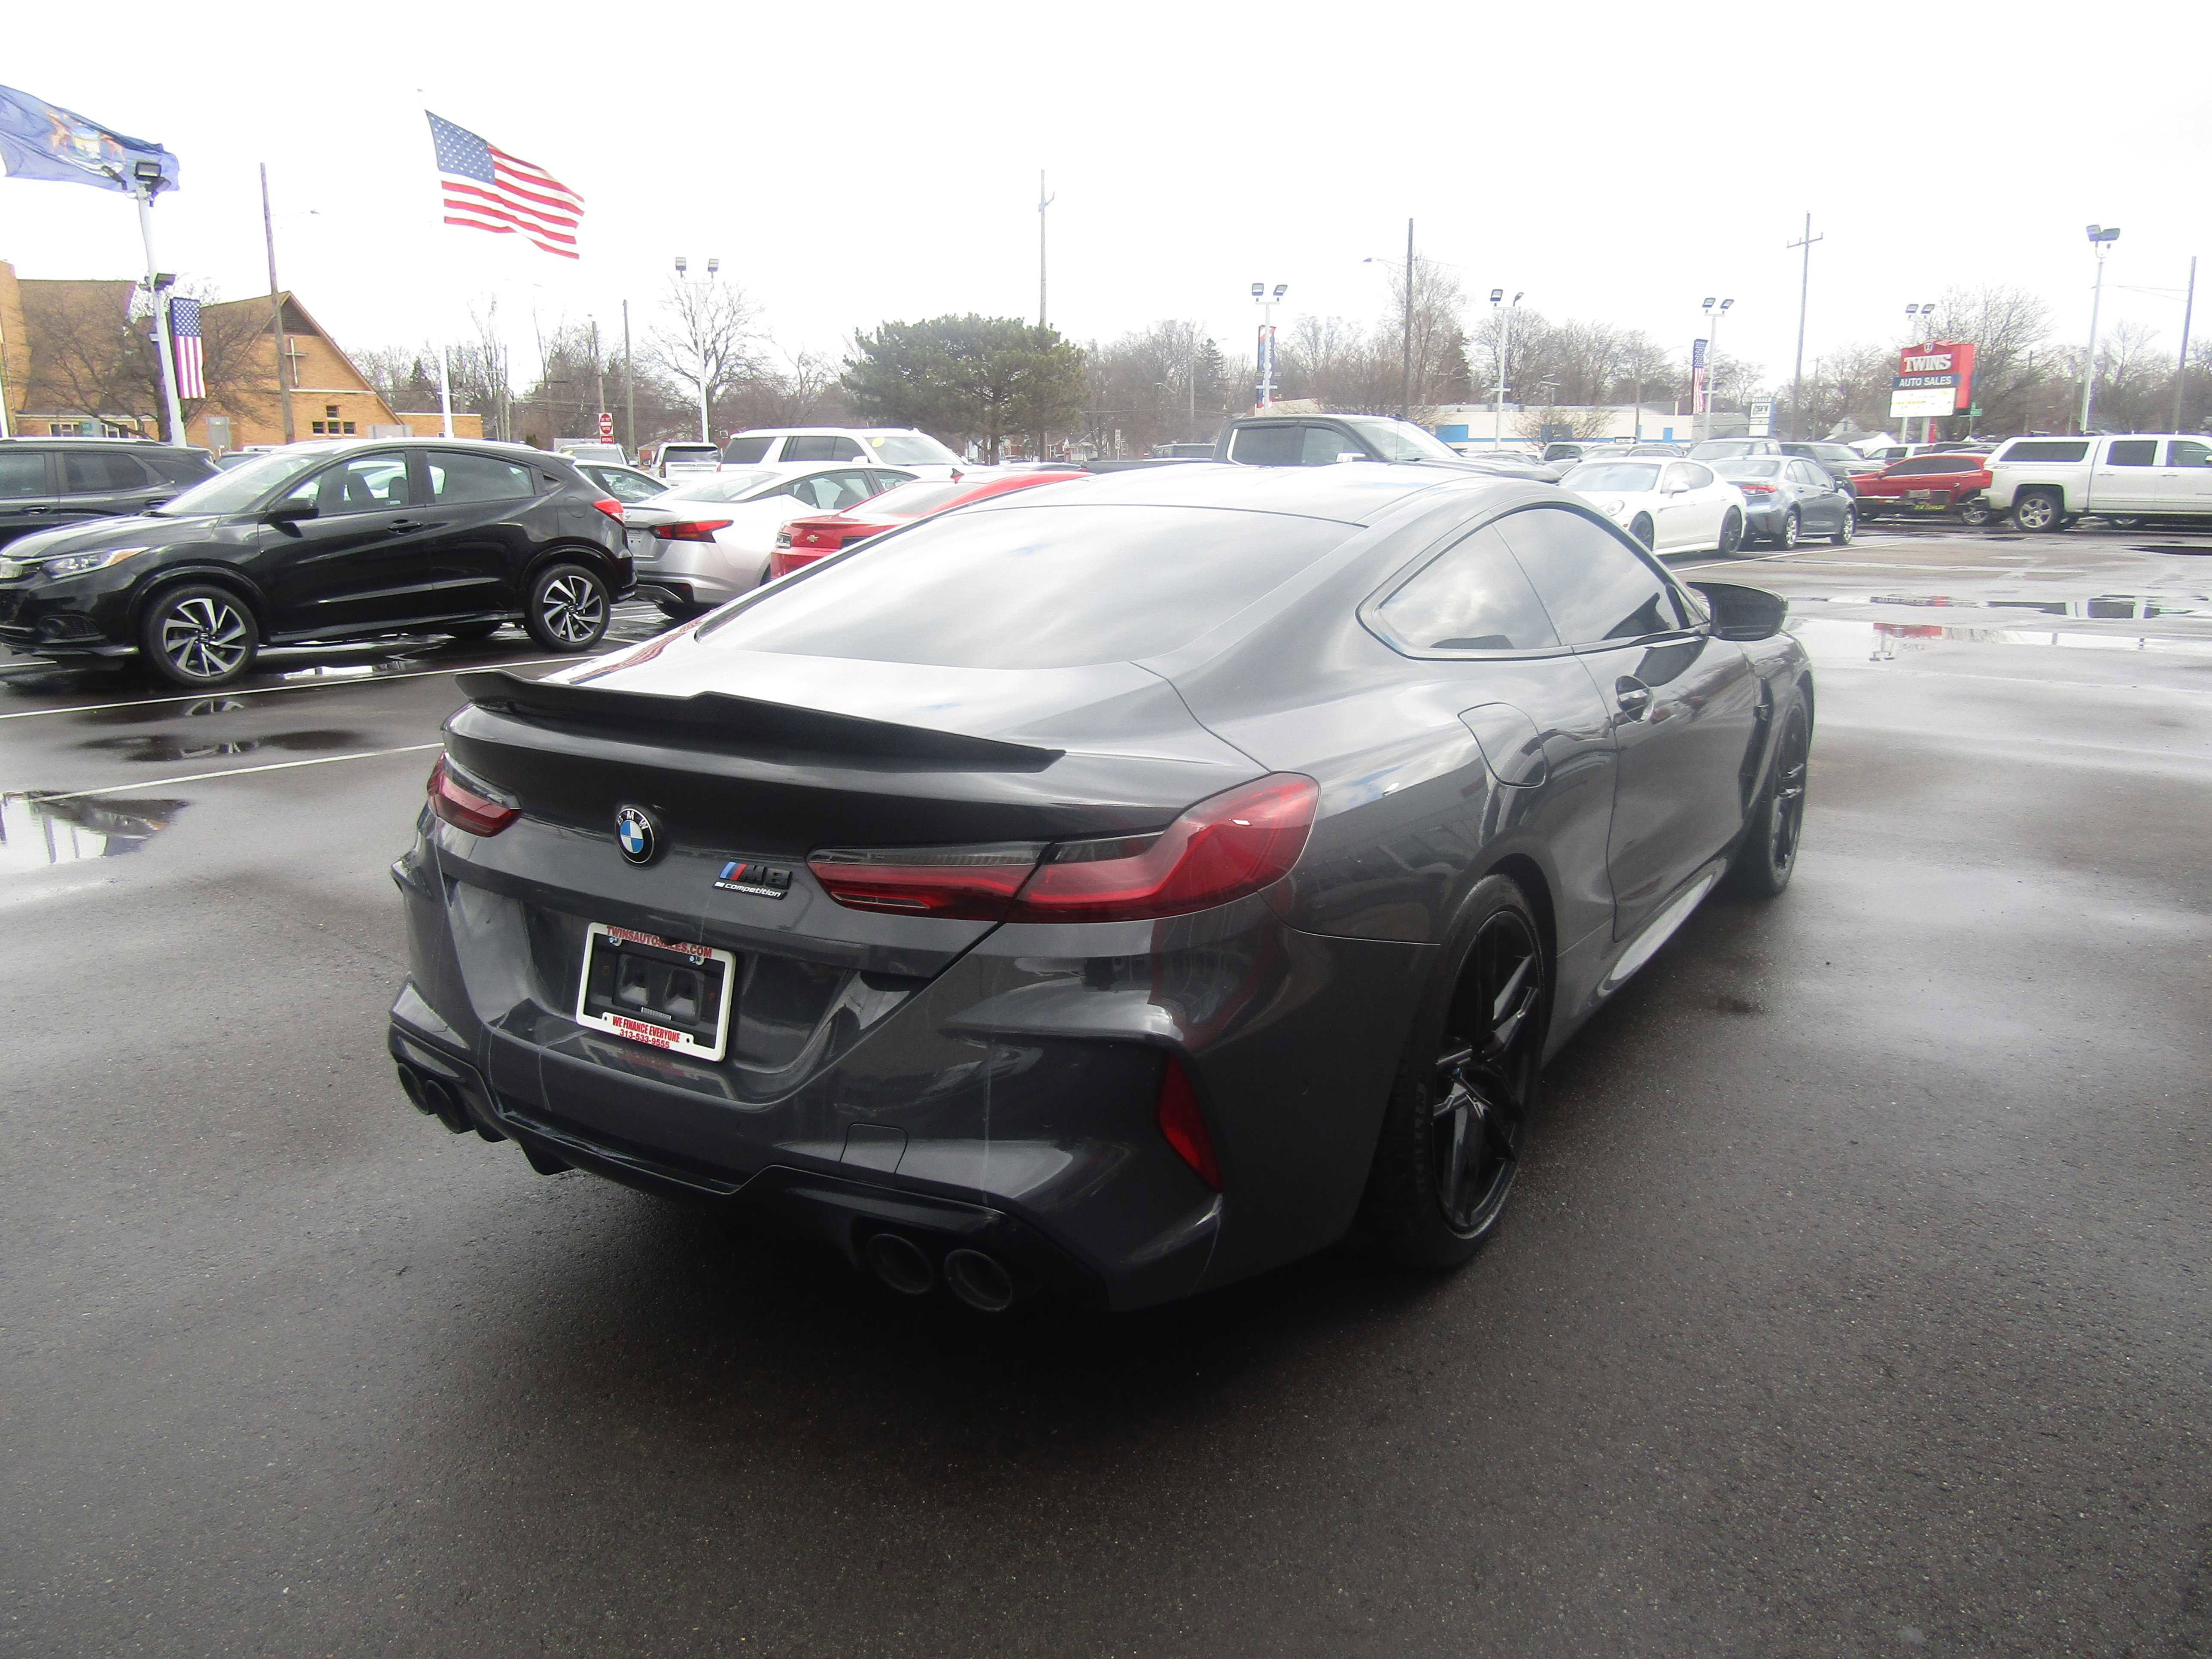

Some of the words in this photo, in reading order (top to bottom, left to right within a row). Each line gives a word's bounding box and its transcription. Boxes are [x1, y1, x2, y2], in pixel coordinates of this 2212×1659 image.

[1904, 354, 1951, 372] TWINS
[1899, 377, 1922, 387] AUTO
[1923, 376, 1951, 386] SALES
[618, 811, 648, 830] BMW
[724, 884, 781, 897] competition
[613, 1016, 623, 1027] WE
[623, 1019, 649, 1034] FINANCE
[649, 1026, 680, 1042] EVERYONE
[620, 1029, 669, 1048] 313-533-9555
